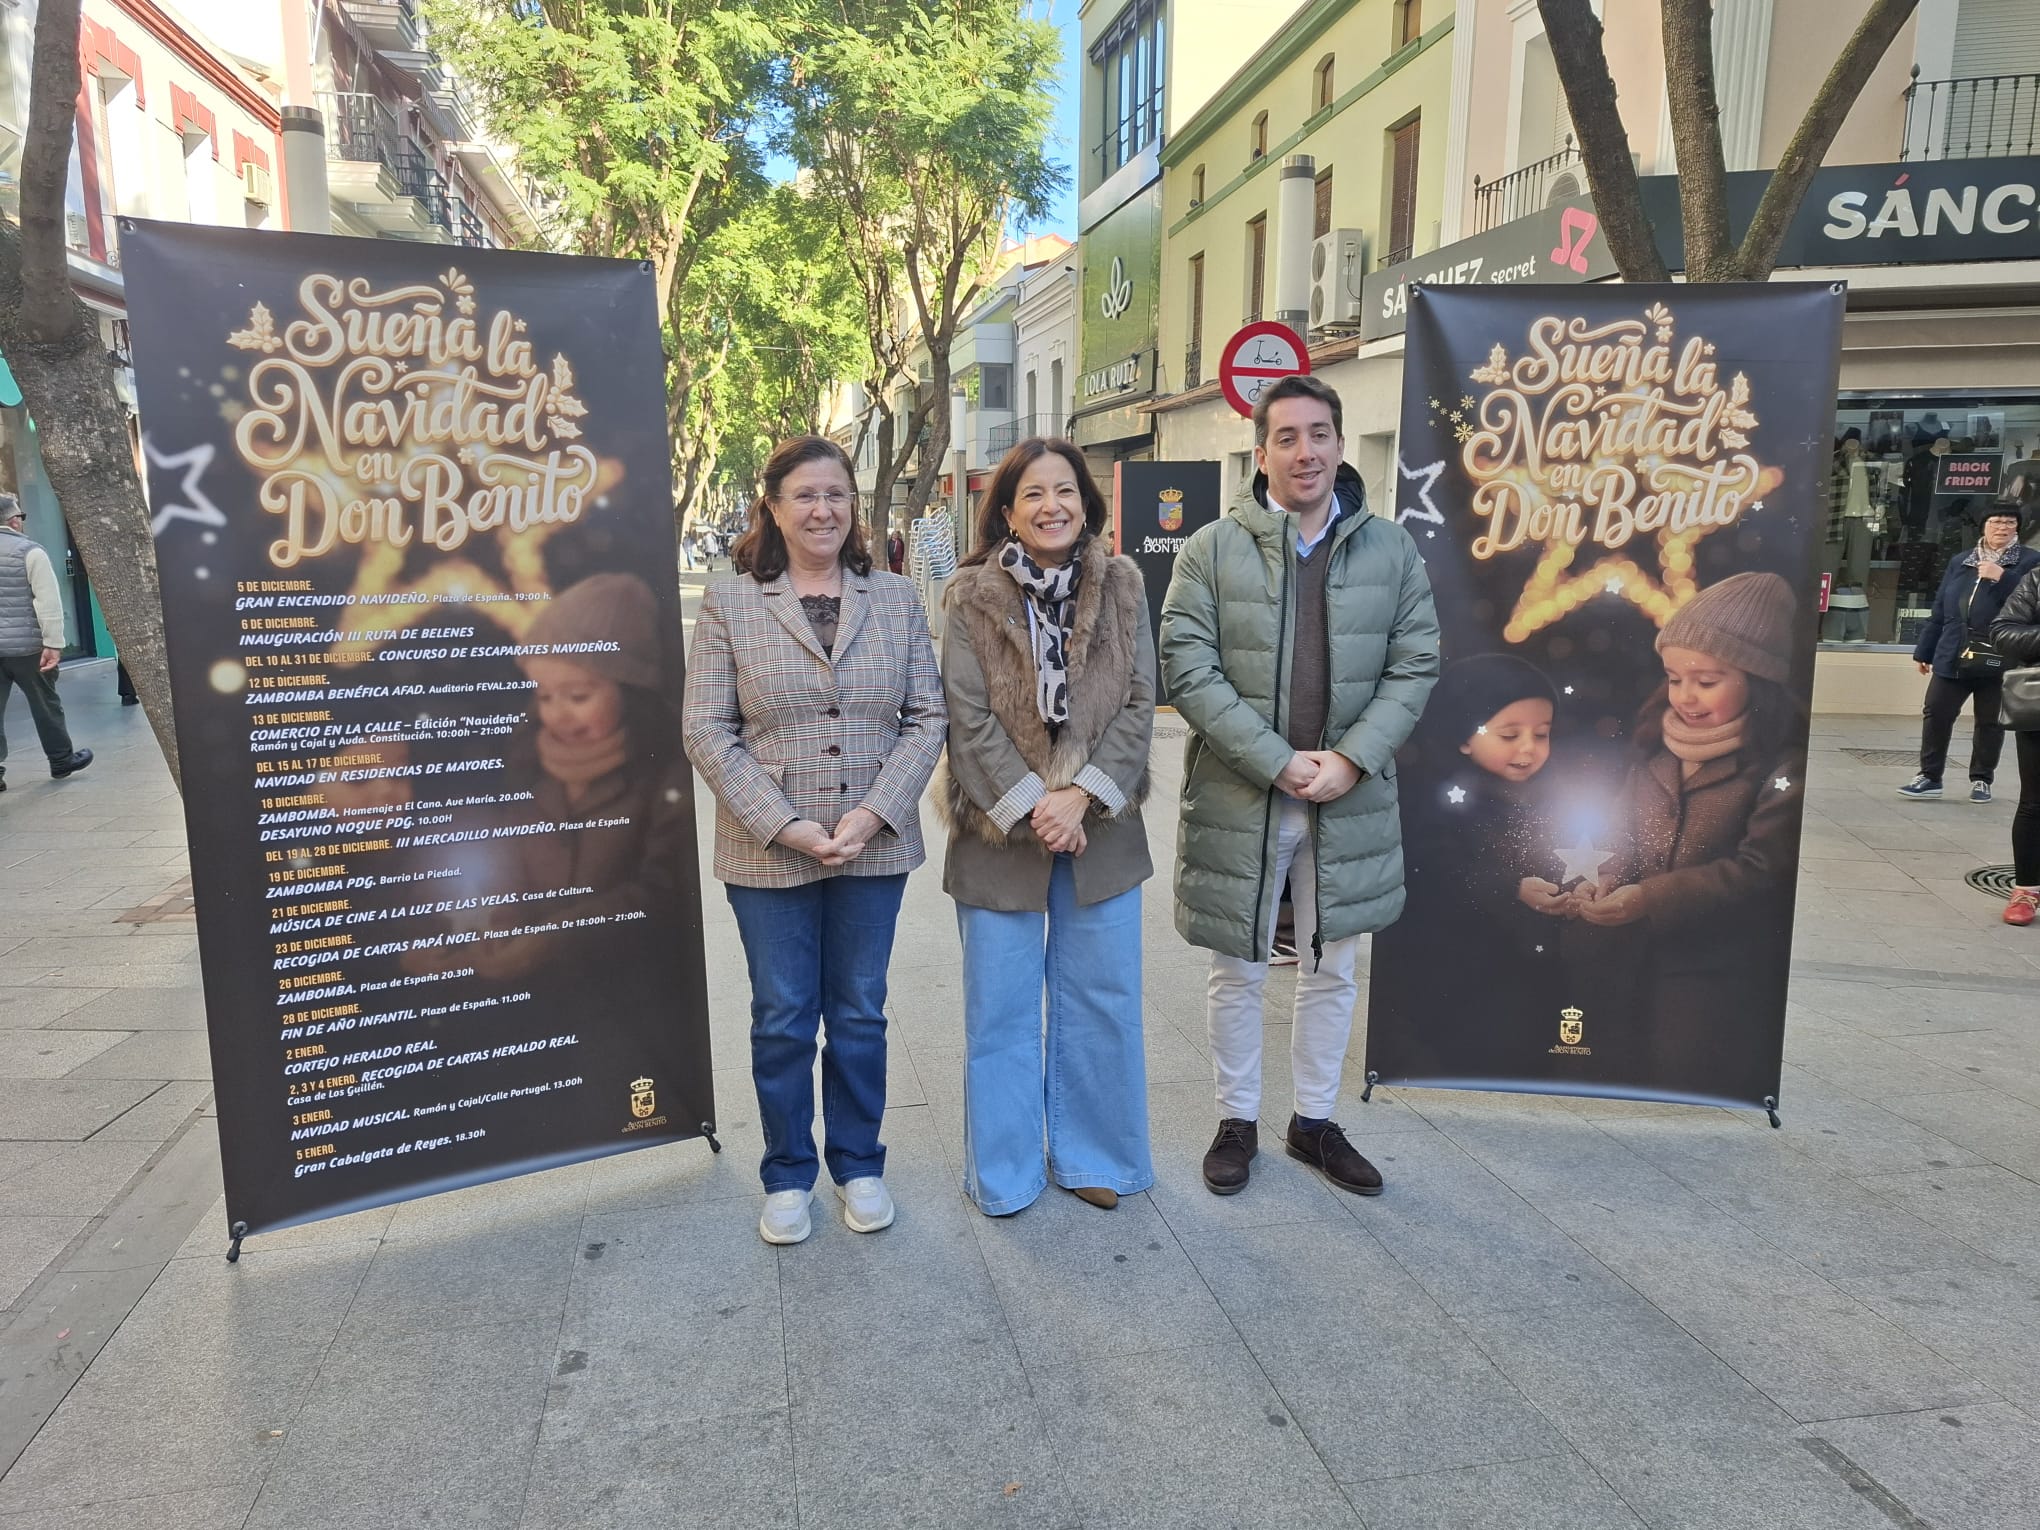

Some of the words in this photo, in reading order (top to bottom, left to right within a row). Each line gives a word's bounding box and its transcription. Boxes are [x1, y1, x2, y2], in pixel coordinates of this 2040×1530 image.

[1490, 256, 1536, 284] secret
[285, 274, 483, 366] Sueña
[487, 310, 537, 377] la
[1513, 316, 1673, 394] Sueña
[1674, 336, 1718, 396] la
[1084, 370, 1107, 396] LOLA
[1110, 360, 1136, 388] RUIZ
[236, 357, 548, 476] Navidad
[1463, 384, 1726, 485] Navidad
[356, 451, 398, 481] en
[1550, 463, 1583, 489] en
[1944, 476, 1992, 486] FRIDAY
[1949, 462, 1990, 472] BLACK
[260, 470, 413, 566] Don
[400, 445, 597, 551] Benito
[1471, 480, 1587, 559] Don
[1583, 455, 1759, 548] Benito
[1144, 544, 1169, 553] DON
[236, 597, 274, 610] GRAN
[277, 594, 356, 607] ENCENDIDO
[360, 592, 429, 604] NAVIDEÑO.
[433, 594, 460, 602] Plaza
[476, 594, 512, 603] España.
[515, 593, 540, 601] 19:00
[240, 629, 344, 646] INAUGURACIÓN
[348, 632, 362, 641] III
[365, 630, 397, 641] RUTA
[401, 629, 418, 639] DE
[421, 627, 474, 638] BELENES
[246, 656, 263, 667] DEL
[267, 655, 277, 665] 10
[281, 655, 292, 665] AL
[295, 654, 306, 664] 31
[310, 654, 321, 664] DE
[324, 652, 375, 663] DICIEMBRE.
[379, 647, 448, 661] CONCURSO
[451, 647, 467, 658] DE
[470, 644, 549, 657] ESCAPARATES
[552, 640, 620, 654] NAVIDEÑOS.
[245, 690, 324, 704] ZAMBOMBA
[328, 685, 389, 700] BENÉFICA
[392, 684, 426, 696] AFAD.
[429, 684, 474, 694] Auditorio
[250, 726, 321, 741] COMERCIO
[324, 725, 342, 736] EN
[345, 724, 360, 734] LA
[364, 721, 402, 732] CALLE
[414, 718, 456, 730] Edición
[251, 742, 287, 752] Ramón
[291, 741, 298, 751] y
[300, 737, 327, 750] Cajal
[330, 739, 335, 747] y
[339, 736, 367, 745] Avda.
[370, 731, 434, 743] Constitución.
[437, 729, 470, 738] 10:00h
[481, 726, 512, 736] 21:00h
[255, 773, 315, 789] NAVIDAD
[319, 771, 337, 783] EN
[340, 765, 422, 782] RESIDENCIAS
[426, 763, 443, 774] DE
[446, 759, 505, 772] MAYORES.
[258, 808, 339, 825] ZAMBOMBA.
[343, 804, 394, 816] Homenaje
[405, 802, 414, 811] El
[417, 800, 443, 809] Cano.
[446, 798, 463, 807] Ave
[466, 795, 496, 805] María.
[499, 791, 534, 801] 20.00h.
[266, 852, 283, 862] DEL
[287, 849, 298, 859] 19
[301, 848, 312, 858] AL
[315, 847, 326, 855] 28
[329, 844, 340, 854] DE
[342, 839, 392, 852] DICIEMBRE.
[396, 838, 410, 848] III
[413, 829, 489, 846] MERCADILLO
[492, 821, 556, 838] NAVIDEÑO.
[559, 822, 583, 831] Plaza
[586, 820, 596, 828] de
[598, 817, 630, 828] España
[266, 881, 343, 899] ZAMBOMBA
[347, 876, 376, 890] PDG.
[380, 874, 411, 885] Barrio
[414, 872, 425, 880] La
[427, 868, 462, 879] Piedad.
[270, 919, 321, 934] MÚSICA
[325, 916, 342, 927] DE
[346, 910, 376, 924] CINE
[379, 909, 388, 919] A
[391, 907, 406, 917] LA
[410, 904, 432, 915] LUZ
[436, 901, 452, 912] DE
[456, 898, 477, 910] LAS
[481, 894, 519, 906] VELAS.
[523, 892, 544, 901] Casa
[559, 885, 593, 896] Cultura.
[273, 949, 339, 970] RECOGIDA
[343, 948, 361, 960] DE
[363, 941, 408, 956] CARTAS
[412, 933, 443, 950] PAPÁ
[446, 933, 480, 945] NOEL.
[484, 930, 509, 940] Plaza
[512, 927, 523, 936] de
[525, 923, 559, 934] España.
[562, 920, 574, 929] De
[576, 916, 605, 927] 18:00h
[615, 911, 647, 922] 21:00h.
[277, 984, 357, 1005] ZAMBOMBA.
[360, 983, 387, 992] Plaza
[390, 980, 401, 988] de
[404, 973, 439, 986] España
[441, 967, 474, 979] 20.30h
[281, 1028, 302, 1040] FIN
[306, 1024, 324, 1035] DE
[327, 1018, 356, 1032] AÑO
[359, 1009, 417, 1028] INFANTIL.
[421, 1008, 447, 1017] Plaza
[449, 1003, 460, 1012] de
[463, 999, 499, 1012] España.
[502, 992, 531, 1003] 11.00h
[284, 1058, 339, 1075] CORTEJO
[343, 1046, 401, 1065] HERALDO
[405, 1040, 437, 1054] REAL.
[361, 1062, 423, 1083] RECOGIDA
[427, 1058, 445, 1069] DE
[447, 1051, 489, 1066] CARTAS
[492, 1040, 546, 1058] HERALDO
[549, 1034, 579, 1048] REAL.
[291, 1120, 349, 1141] NAVIDAD
[353, 1109, 410, 1129] MUSICAL.
[414, 1103, 447, 1117] Ramón
[450, 1103, 456, 1111] y
[511, 1082, 551, 1097] Portugal.
[554, 1077, 582, 1089] 13.00h
[295, 1161, 326, 1178] Gran
[330, 1147, 393, 1168] Cabalgata
[397, 1143, 411, 1153] de
[414, 1135, 452, 1151] Reyes.
[456, 1128, 485, 1142] 18.30h
